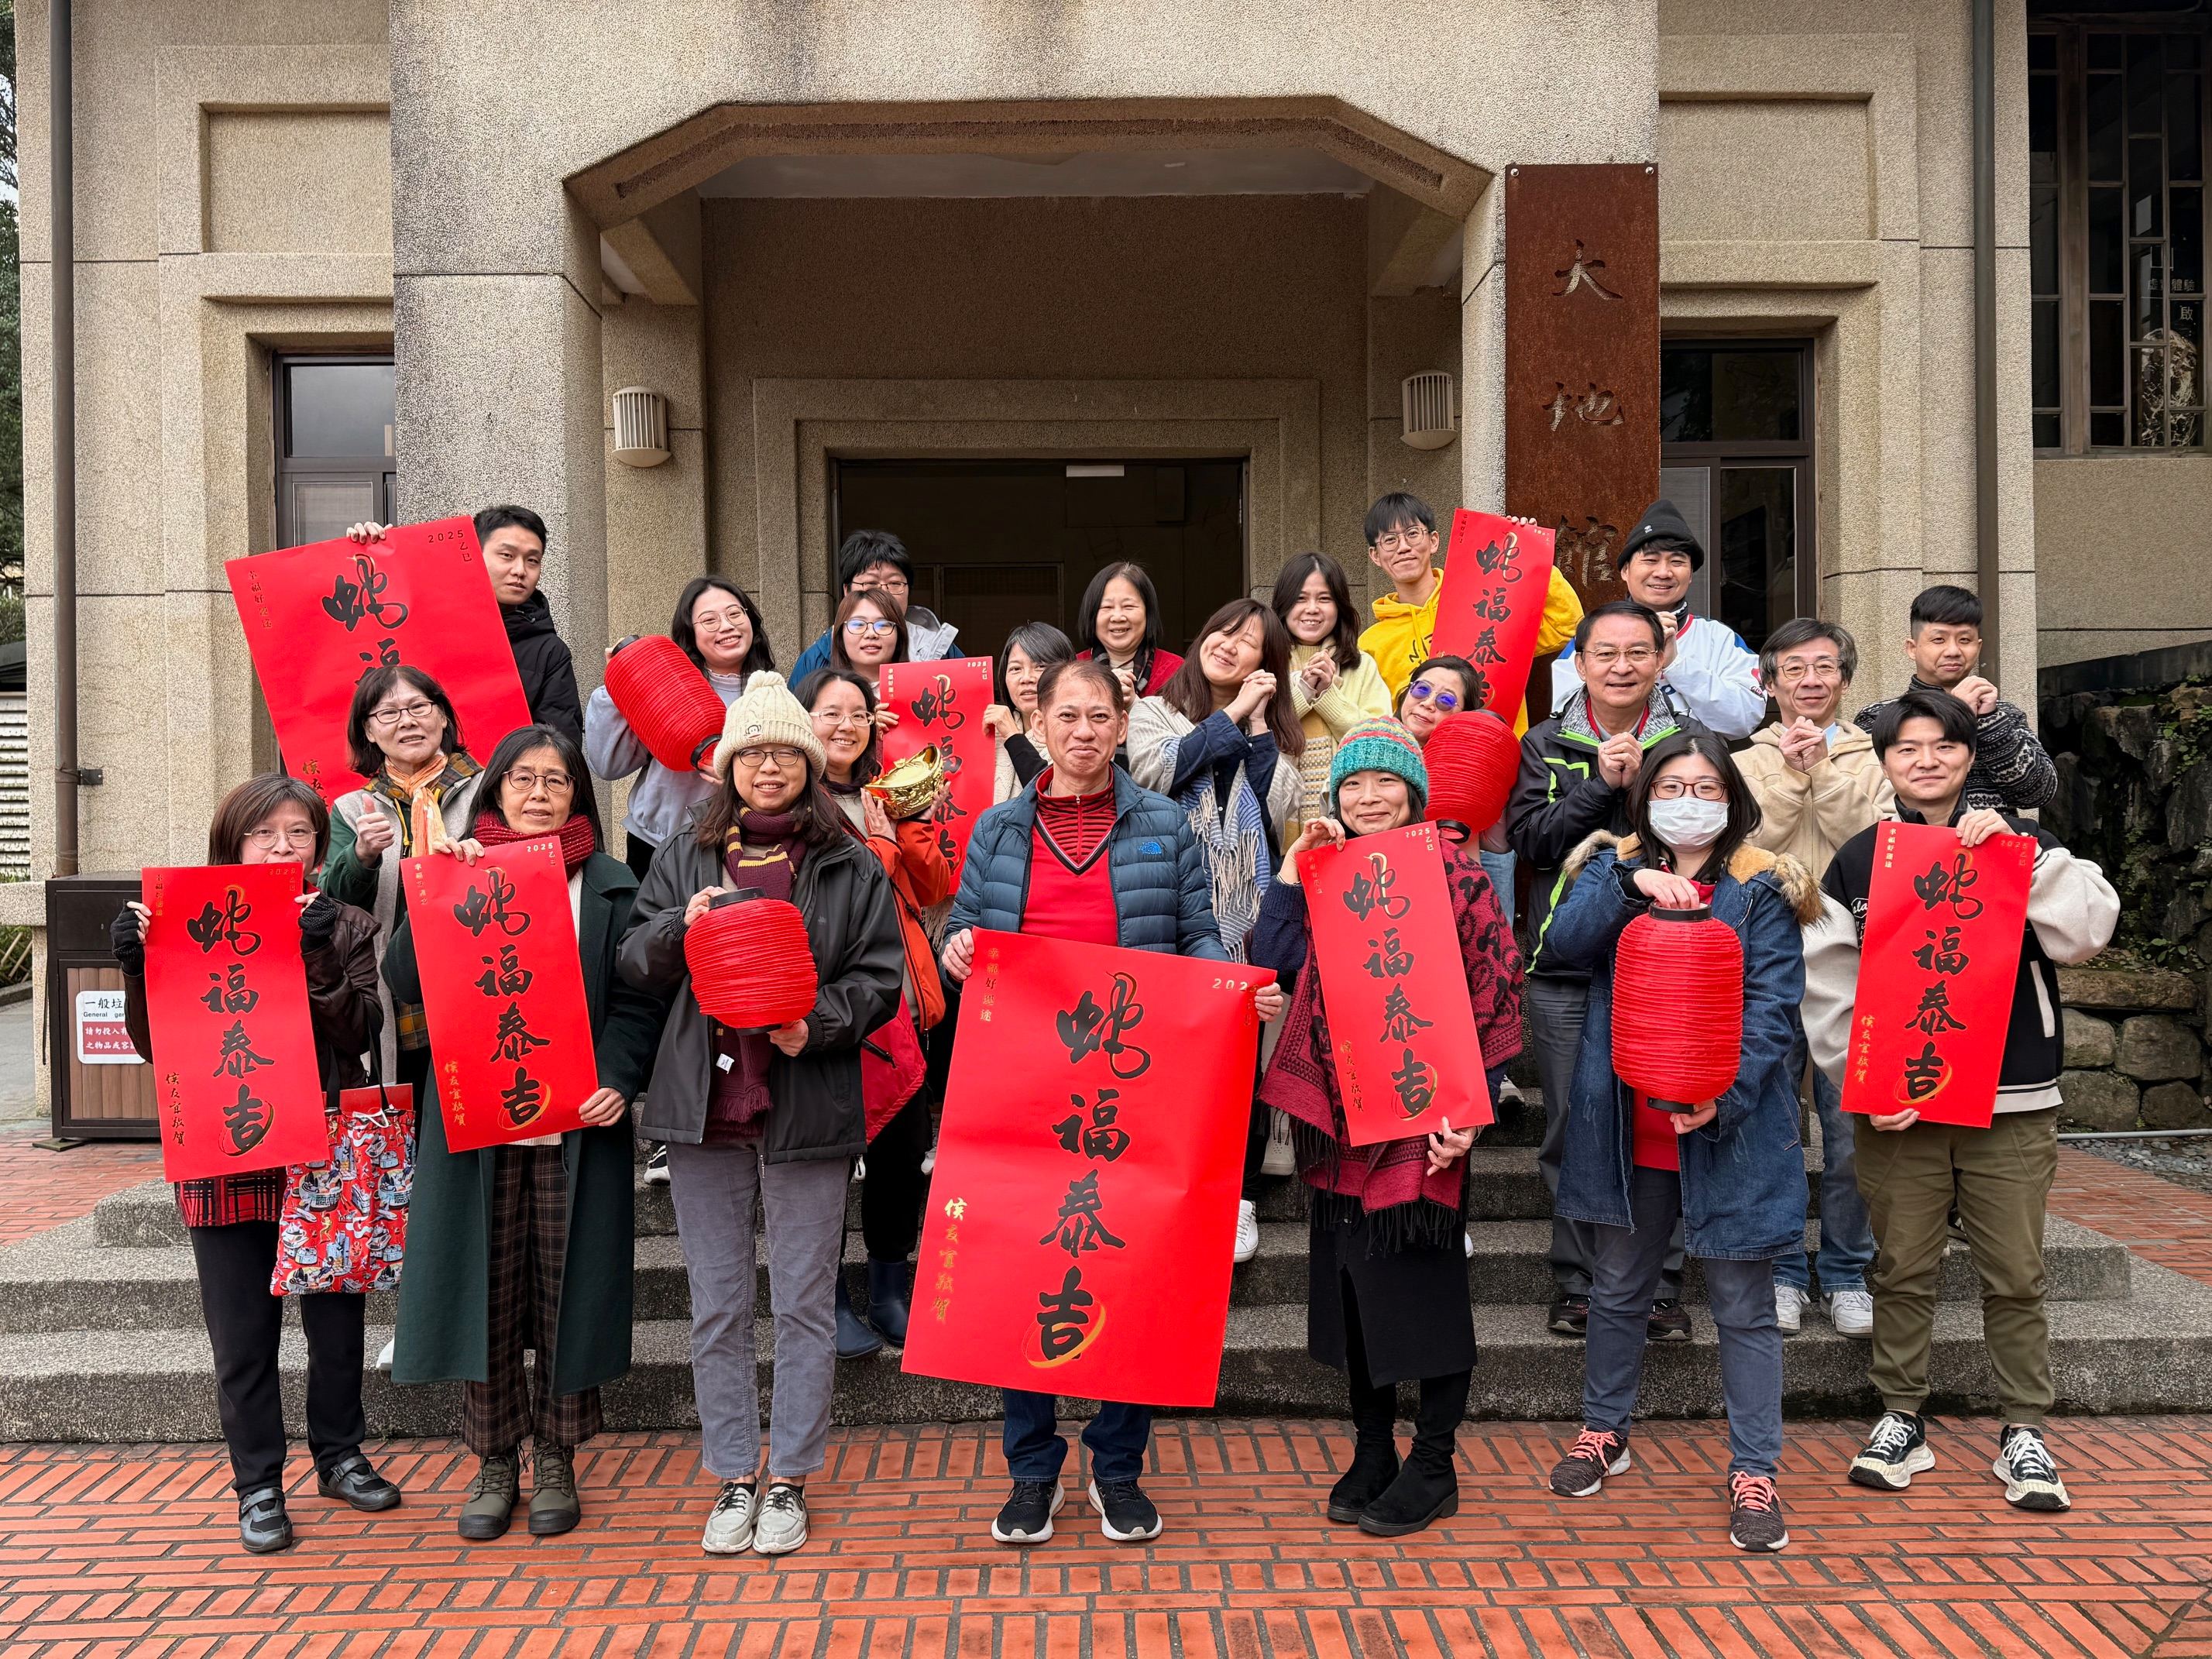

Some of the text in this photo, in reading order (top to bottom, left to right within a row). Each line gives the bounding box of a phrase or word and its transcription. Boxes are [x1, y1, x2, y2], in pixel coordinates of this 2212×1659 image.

[428, 530, 464, 543] 2025
[1541, 239, 1624, 589] 大地館
[526, 842, 554, 853] 2025
[1905, 851, 1984, 1101] 蛇福泰吉
[187, 884, 275, 1155] 蛇福泰吉
[453, 867, 551, 1128] 蛇福泰吉
[1342, 852, 1434, 1119] 蛇福泰吉
[1036, 972, 1152, 1362] 蛇福泰吉
